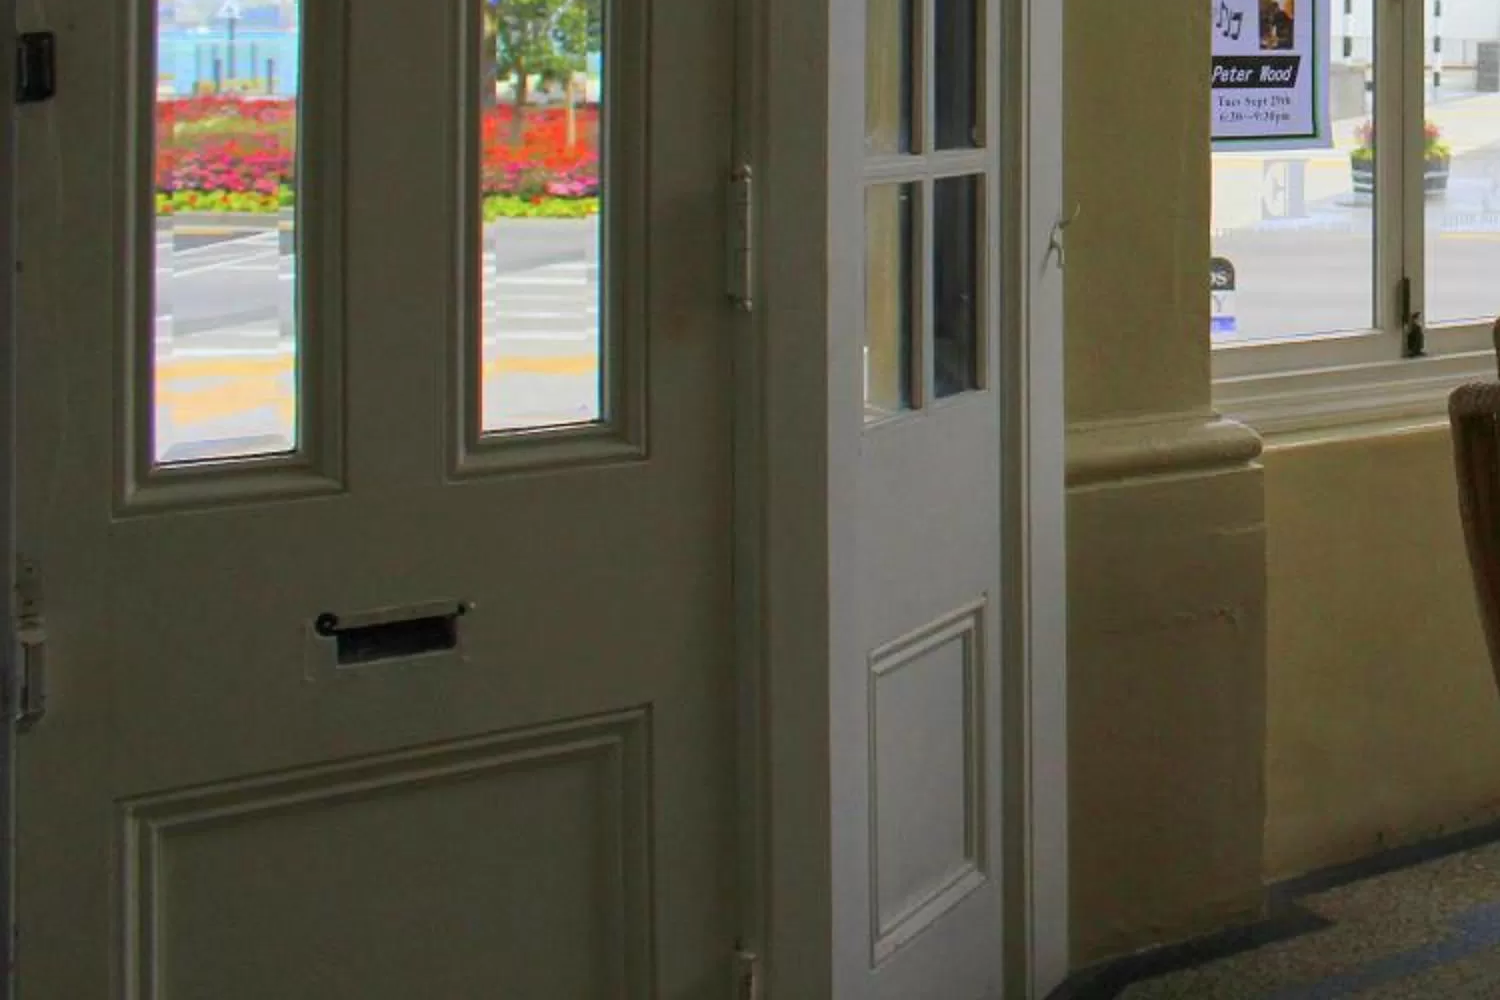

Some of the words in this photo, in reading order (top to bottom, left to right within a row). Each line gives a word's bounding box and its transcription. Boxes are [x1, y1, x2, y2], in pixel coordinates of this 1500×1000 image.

[1212, 65, 1253, 83] Peter
[1259, 65, 1293, 83] Wood
[1244, 96, 1267, 109] Sept
